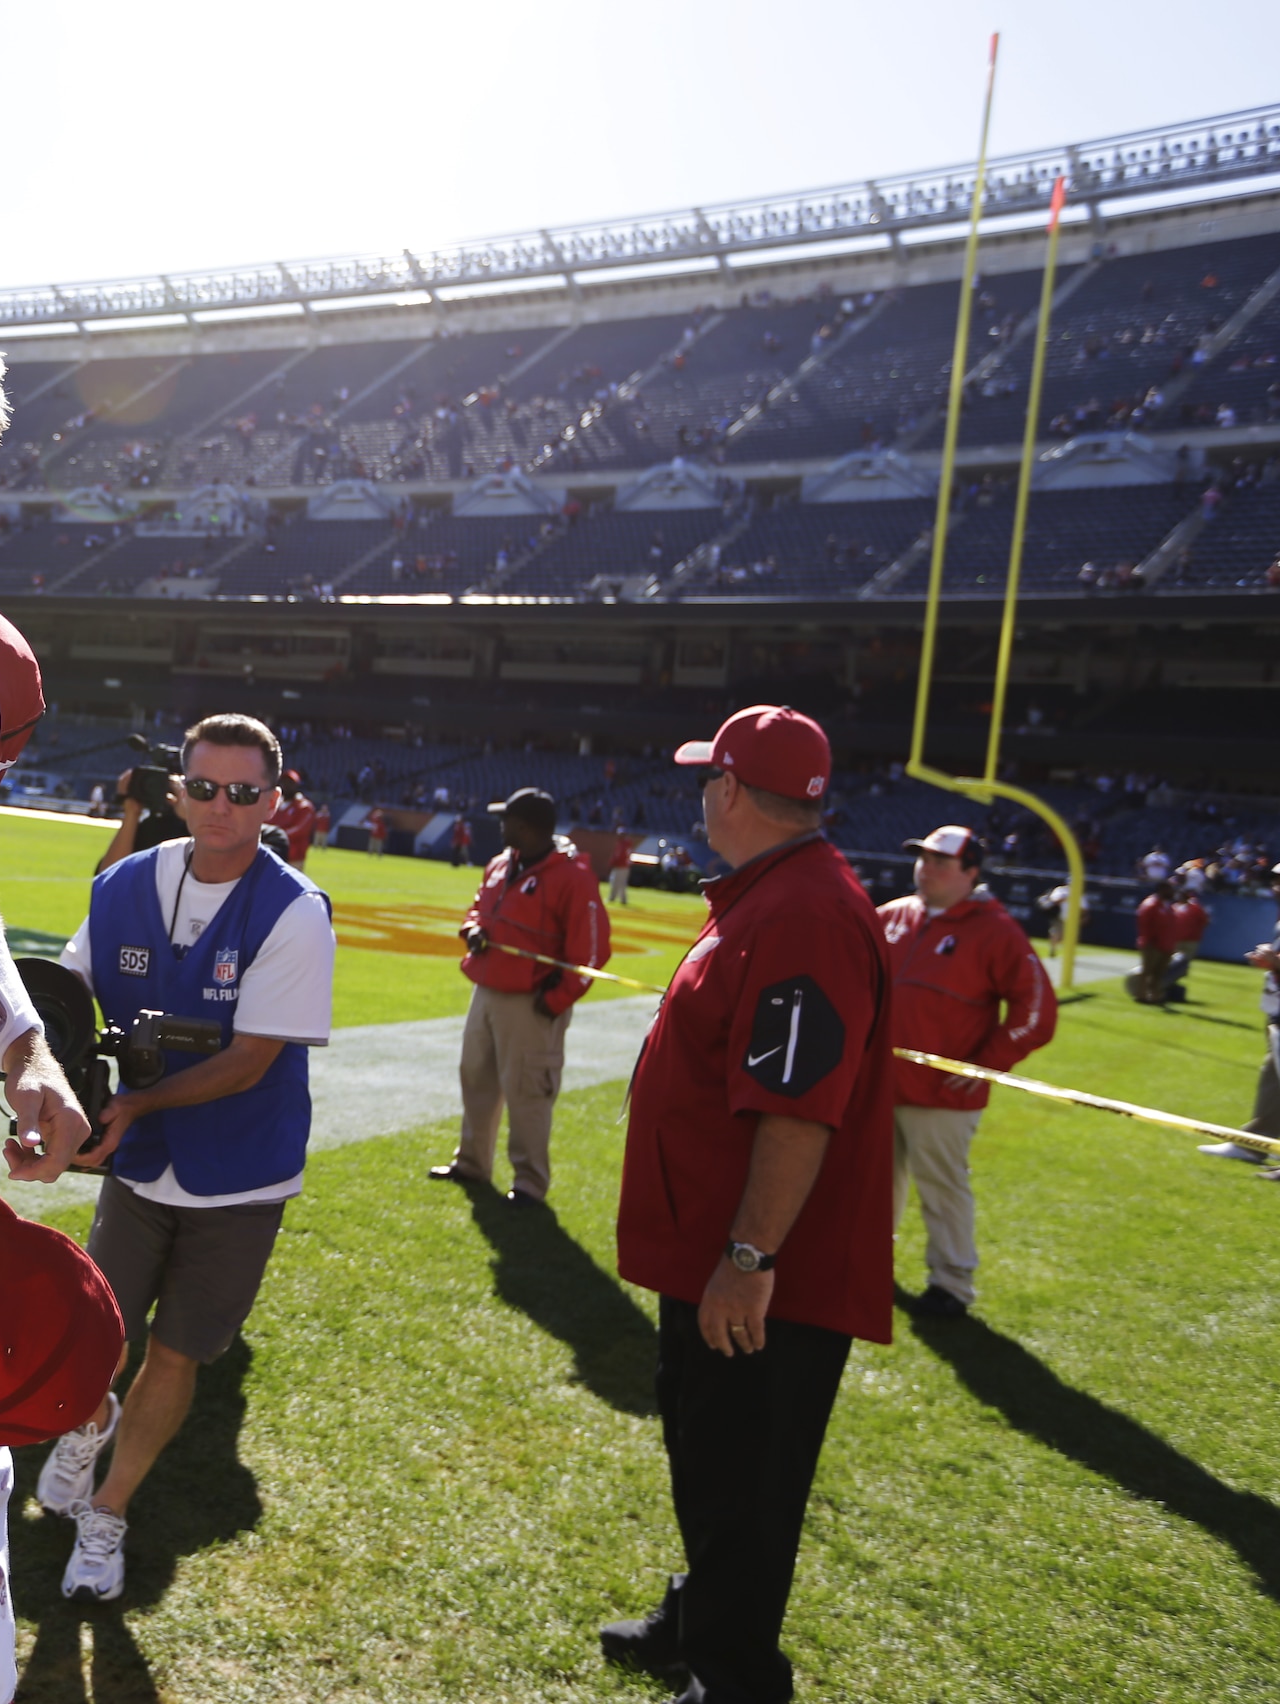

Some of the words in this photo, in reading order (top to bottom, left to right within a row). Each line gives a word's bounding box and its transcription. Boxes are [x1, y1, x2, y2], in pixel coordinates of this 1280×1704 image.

[121, 951, 147, 971] SDS
[215, 964, 234, 980] NFL
[203, 988, 218, 1000] NFL
